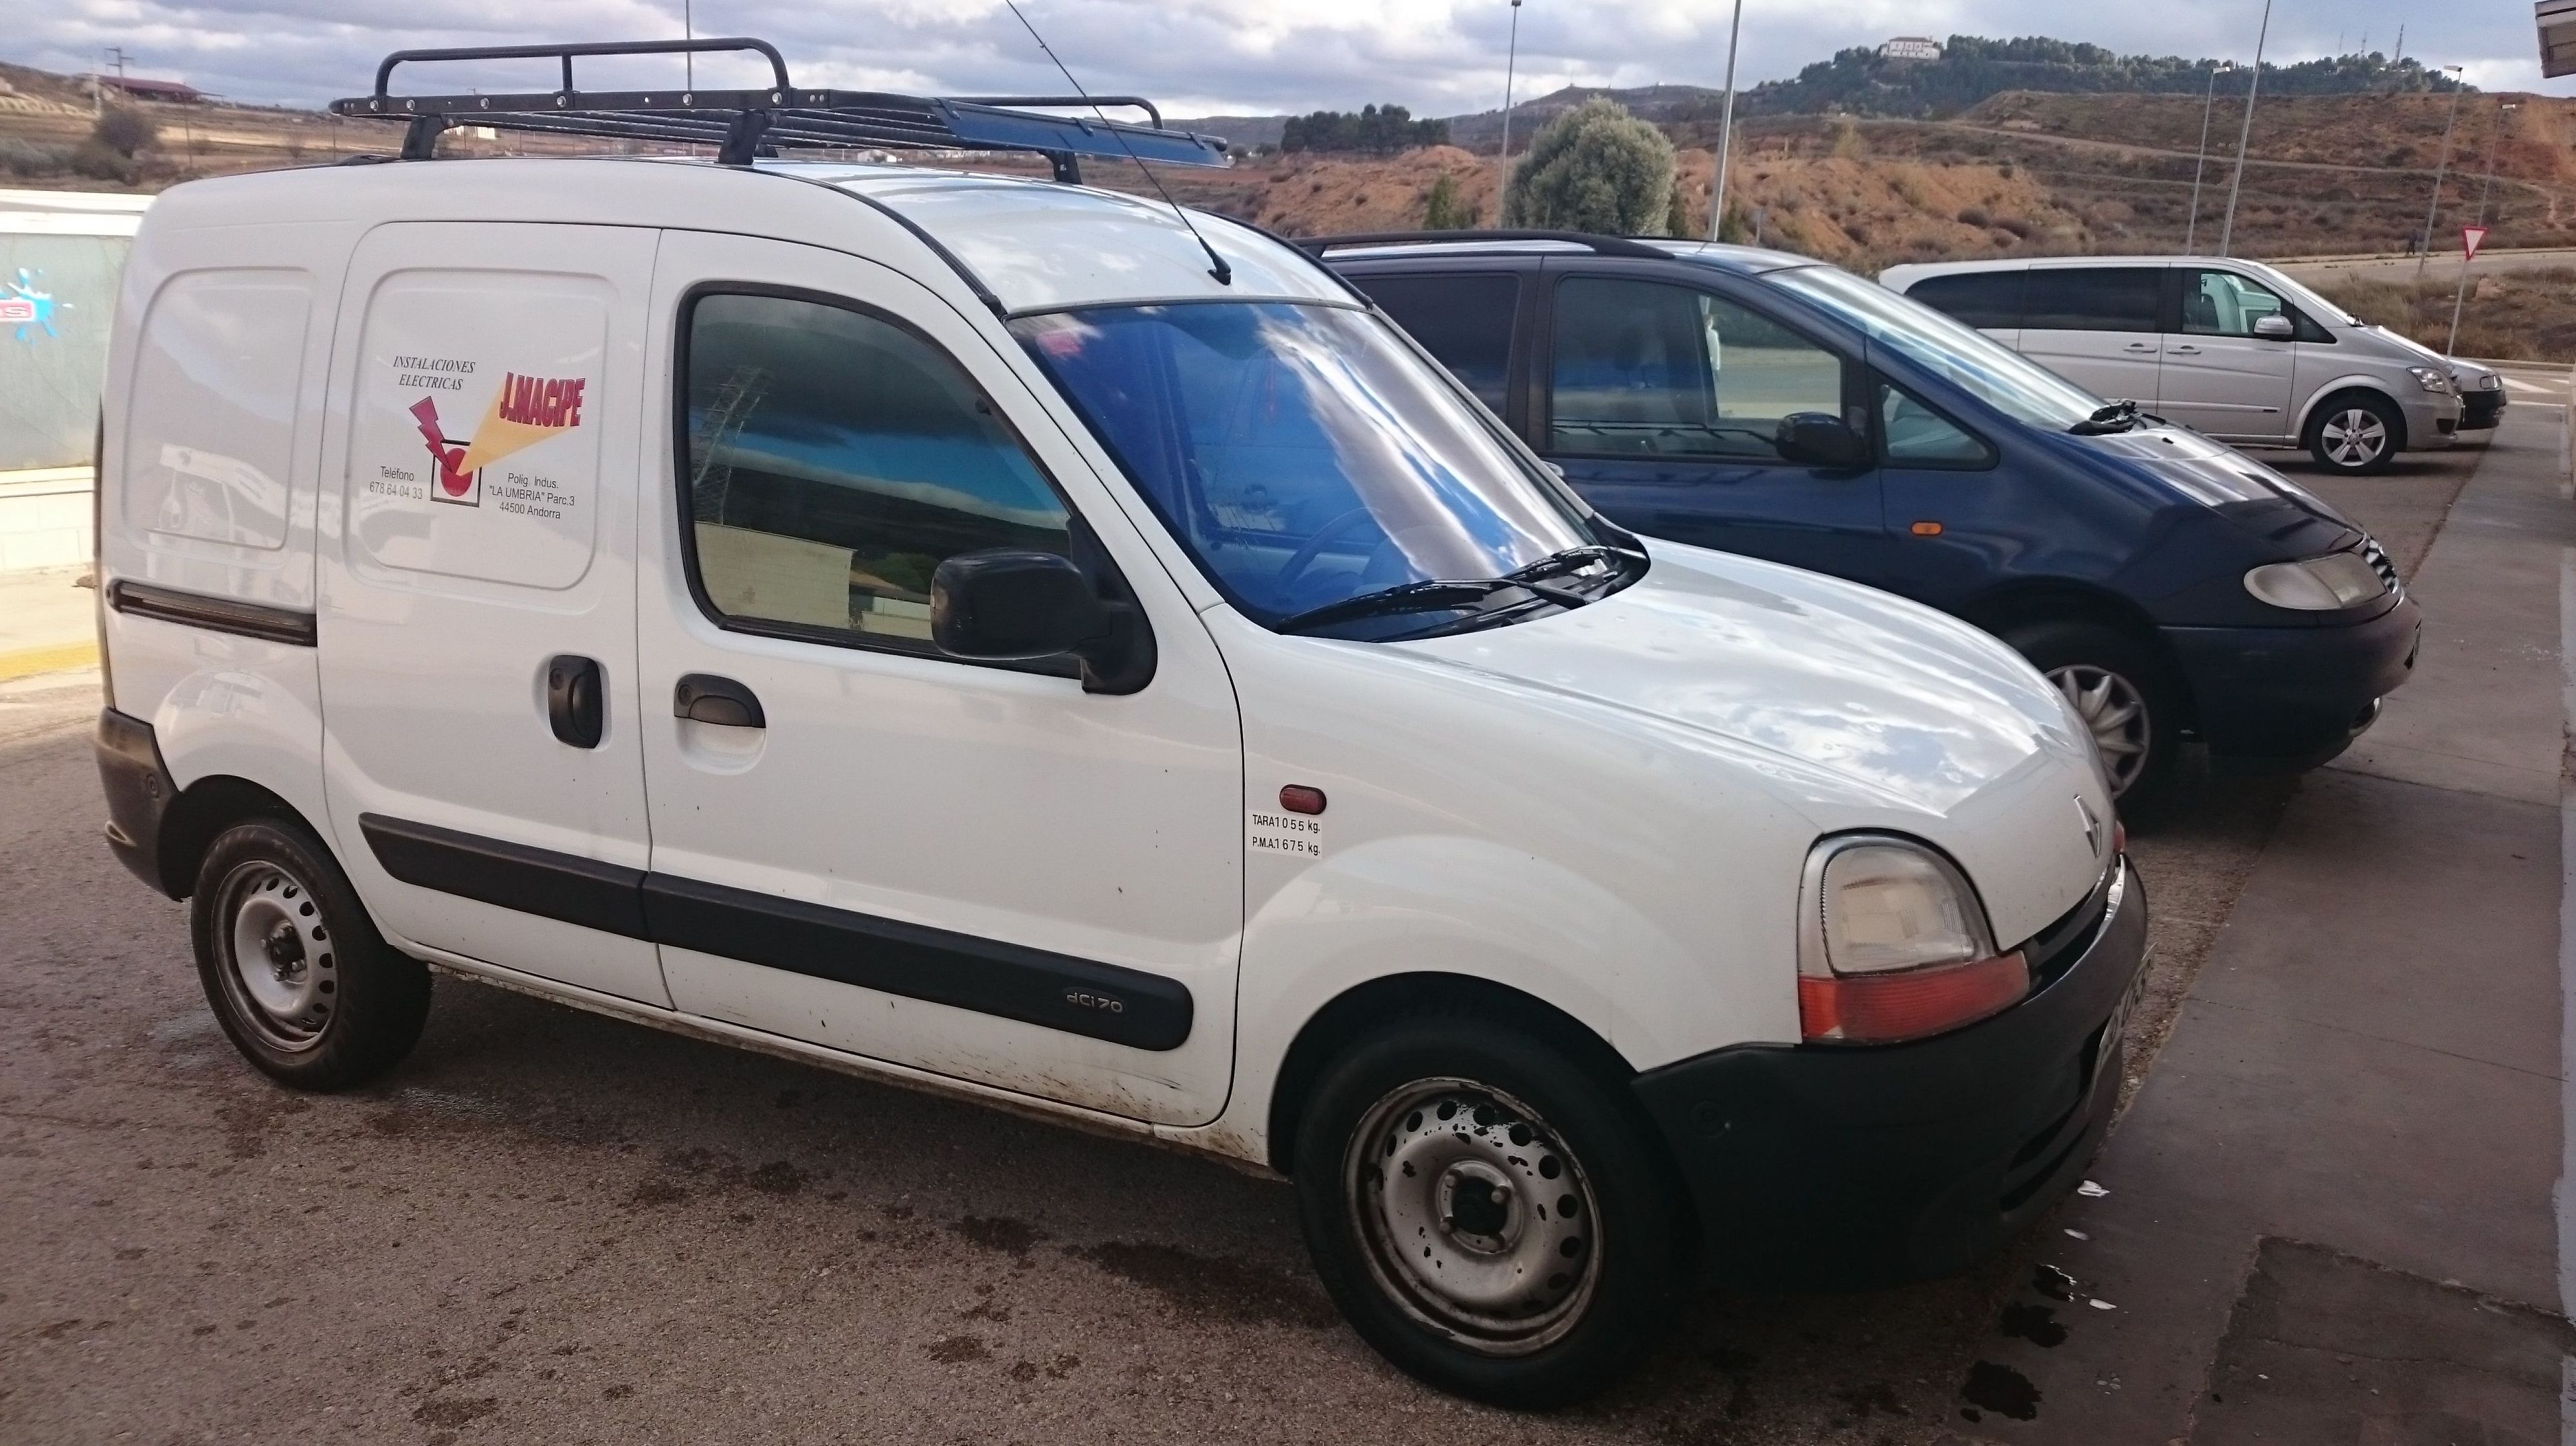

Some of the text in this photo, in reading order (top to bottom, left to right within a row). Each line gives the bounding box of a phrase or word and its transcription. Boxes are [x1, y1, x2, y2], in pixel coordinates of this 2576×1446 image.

[393, 356, 476, 373] INSTALACIONES
[399, 374, 463, 390] ELECTRICAS
[370, 481, 422, 499] 678 64 04 33
[534, 476, 558, 488] Indus.
[489, 485, 503, 496] "LA
[506, 488, 544, 502] UMBRIA"
[500, 502, 560, 519] 44500 Andorra
[1308, 819, 1320, 834] kg.
[1308, 841, 1320, 856] kg.
